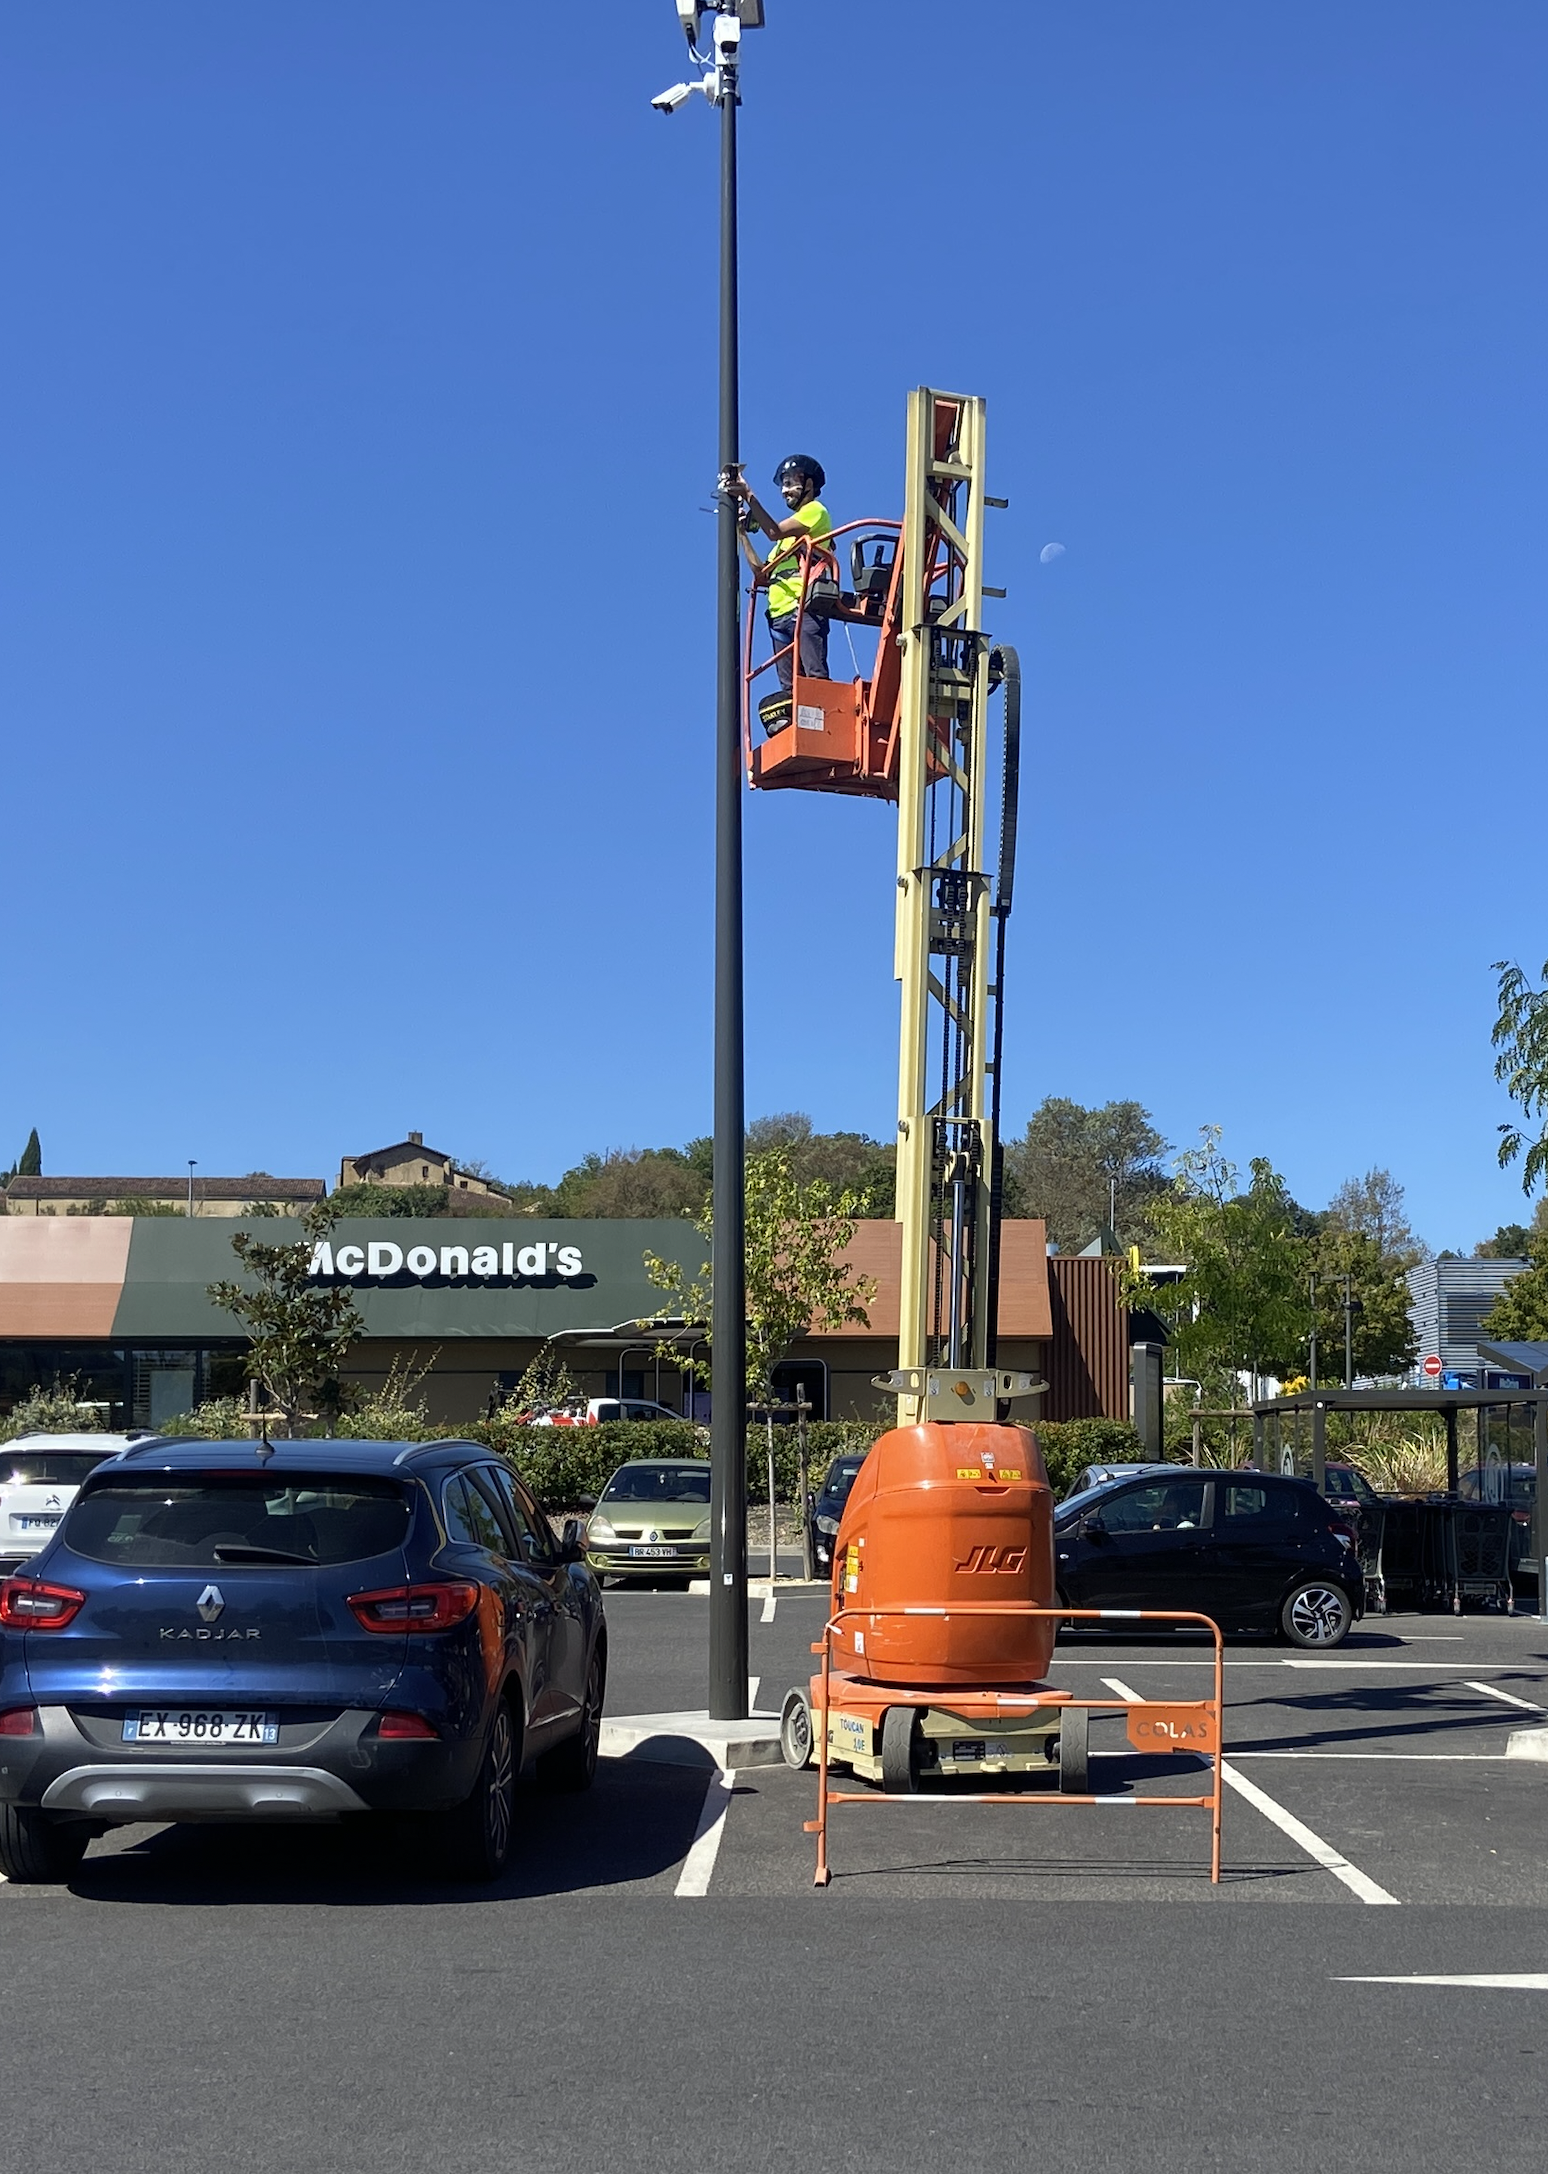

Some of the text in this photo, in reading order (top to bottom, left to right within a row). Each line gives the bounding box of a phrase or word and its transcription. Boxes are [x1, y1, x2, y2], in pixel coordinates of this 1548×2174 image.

[301, 1241, 582, 1276] McDonald's
[953, 1545, 1028, 1574] JLG
[159, 1628, 262, 1640] KADJAR
[264, 1728, 276, 1740] 13
[840, 1718, 864, 1734] TOUCAN
[1136, 1721, 1207, 1739] COLAS
